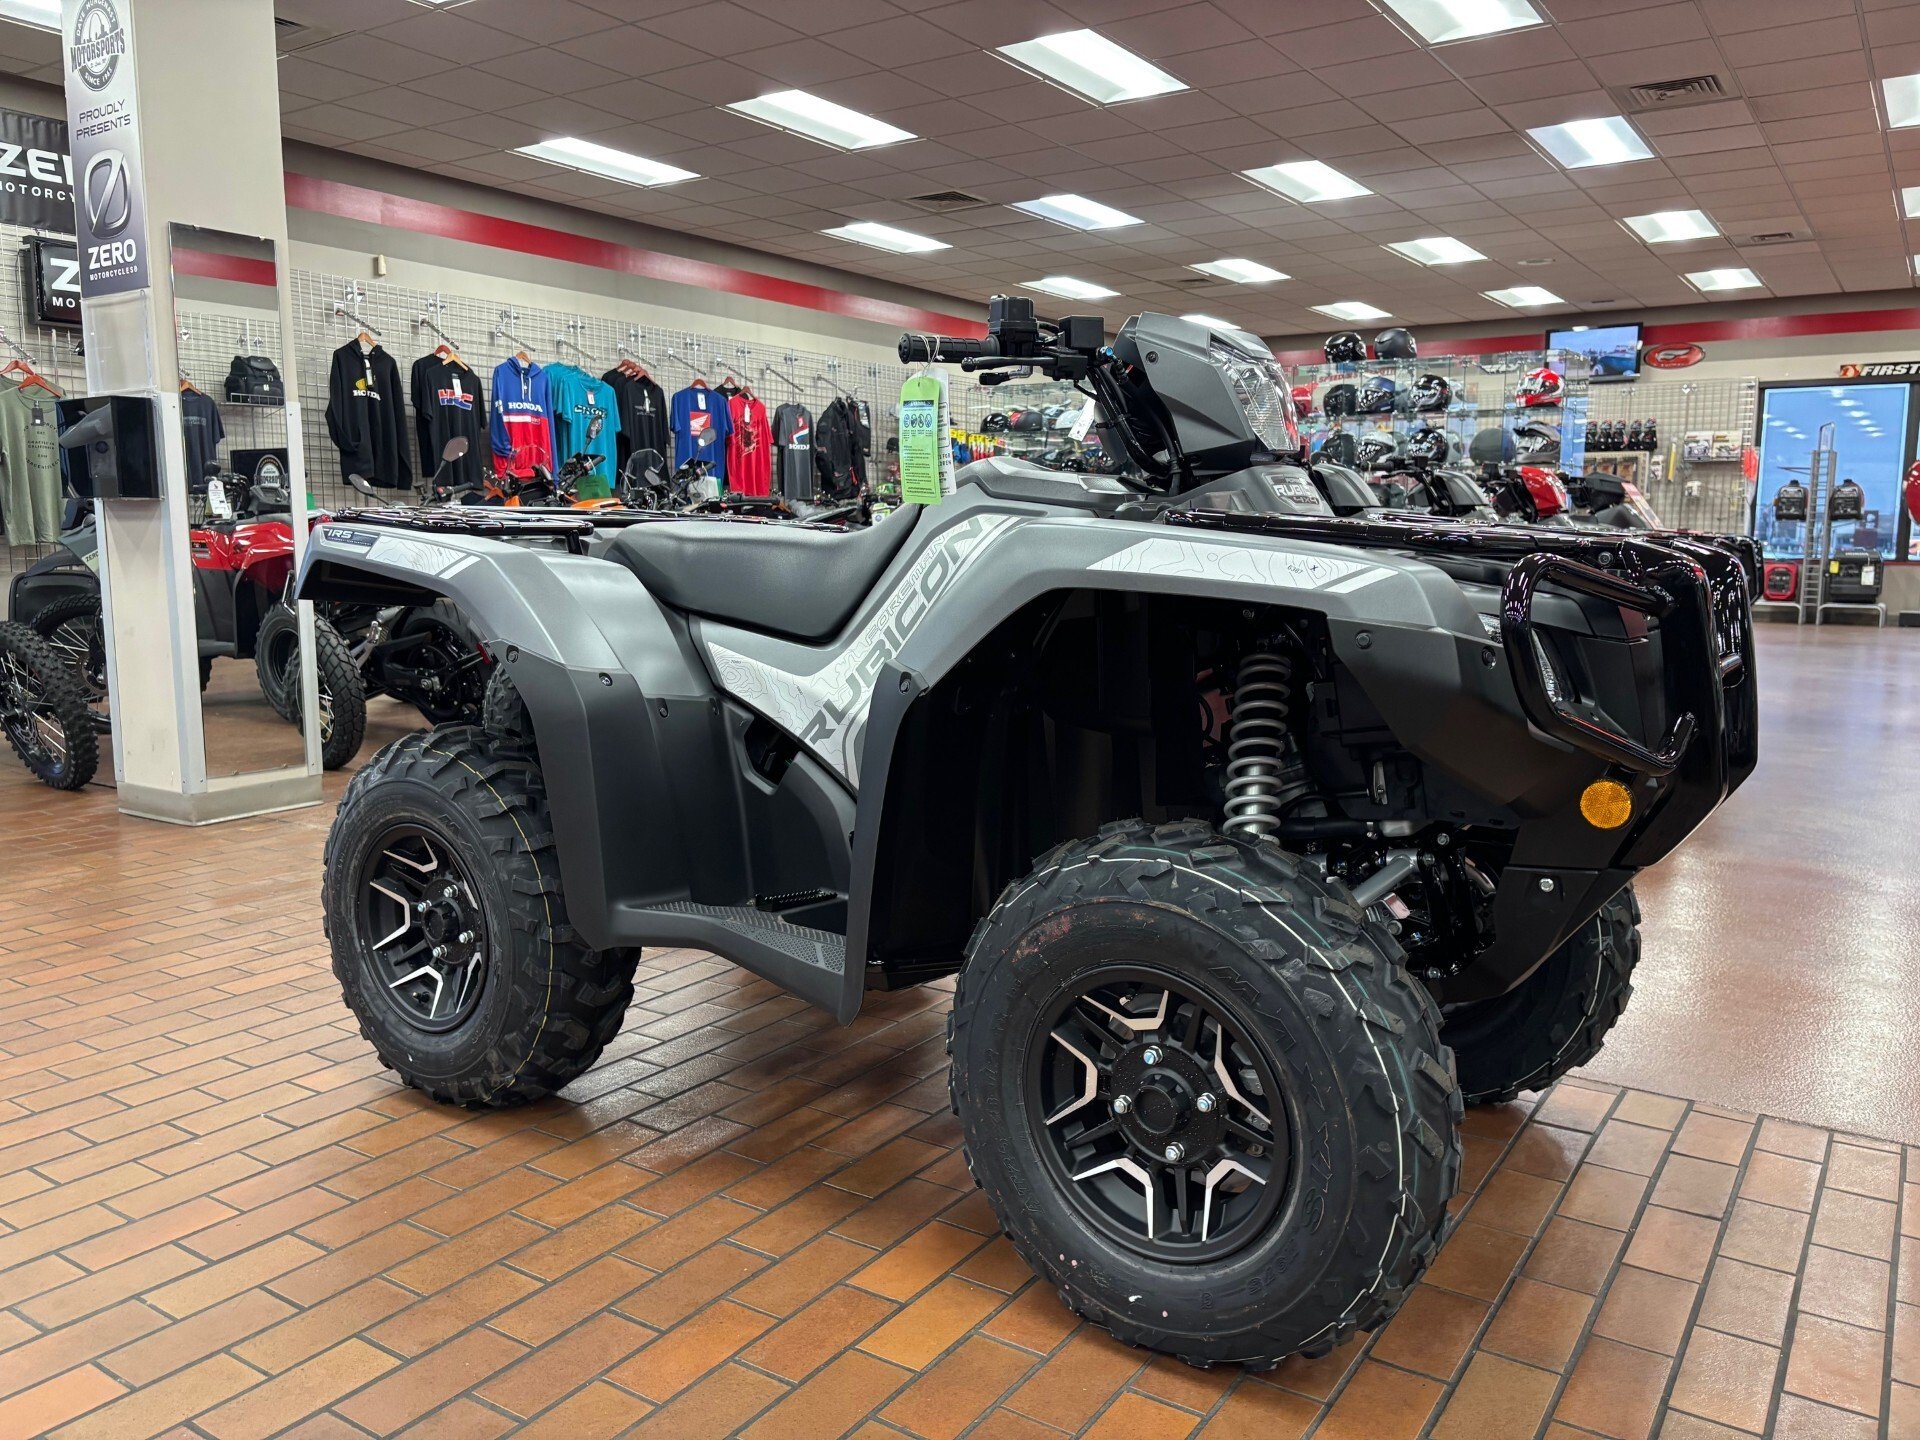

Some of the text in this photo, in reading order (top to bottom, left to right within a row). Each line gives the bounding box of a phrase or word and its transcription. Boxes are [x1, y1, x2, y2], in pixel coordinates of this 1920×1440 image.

[76, 11, 86, 37] DAVE
[70, 28, 125, 73] MOTORSPORTS
[84, 72, 101, 86] SINCE
[79, 99, 125, 123] PROUDLY
[76, 114, 131, 140] PRESENTS
[0, 181, 75, 203] OTORCY
[88, 239, 137, 270] ZERO
[1860, 363, 1920, 377] FIRST
[507, 401, 543, 413] HONDA
[328, 529, 353, 539] IRS
[864, 533, 950, 648] FOREMAN
[800, 516, 984, 746] RUBICON
[1208, 965, 1333, 1235] MAXXIS
